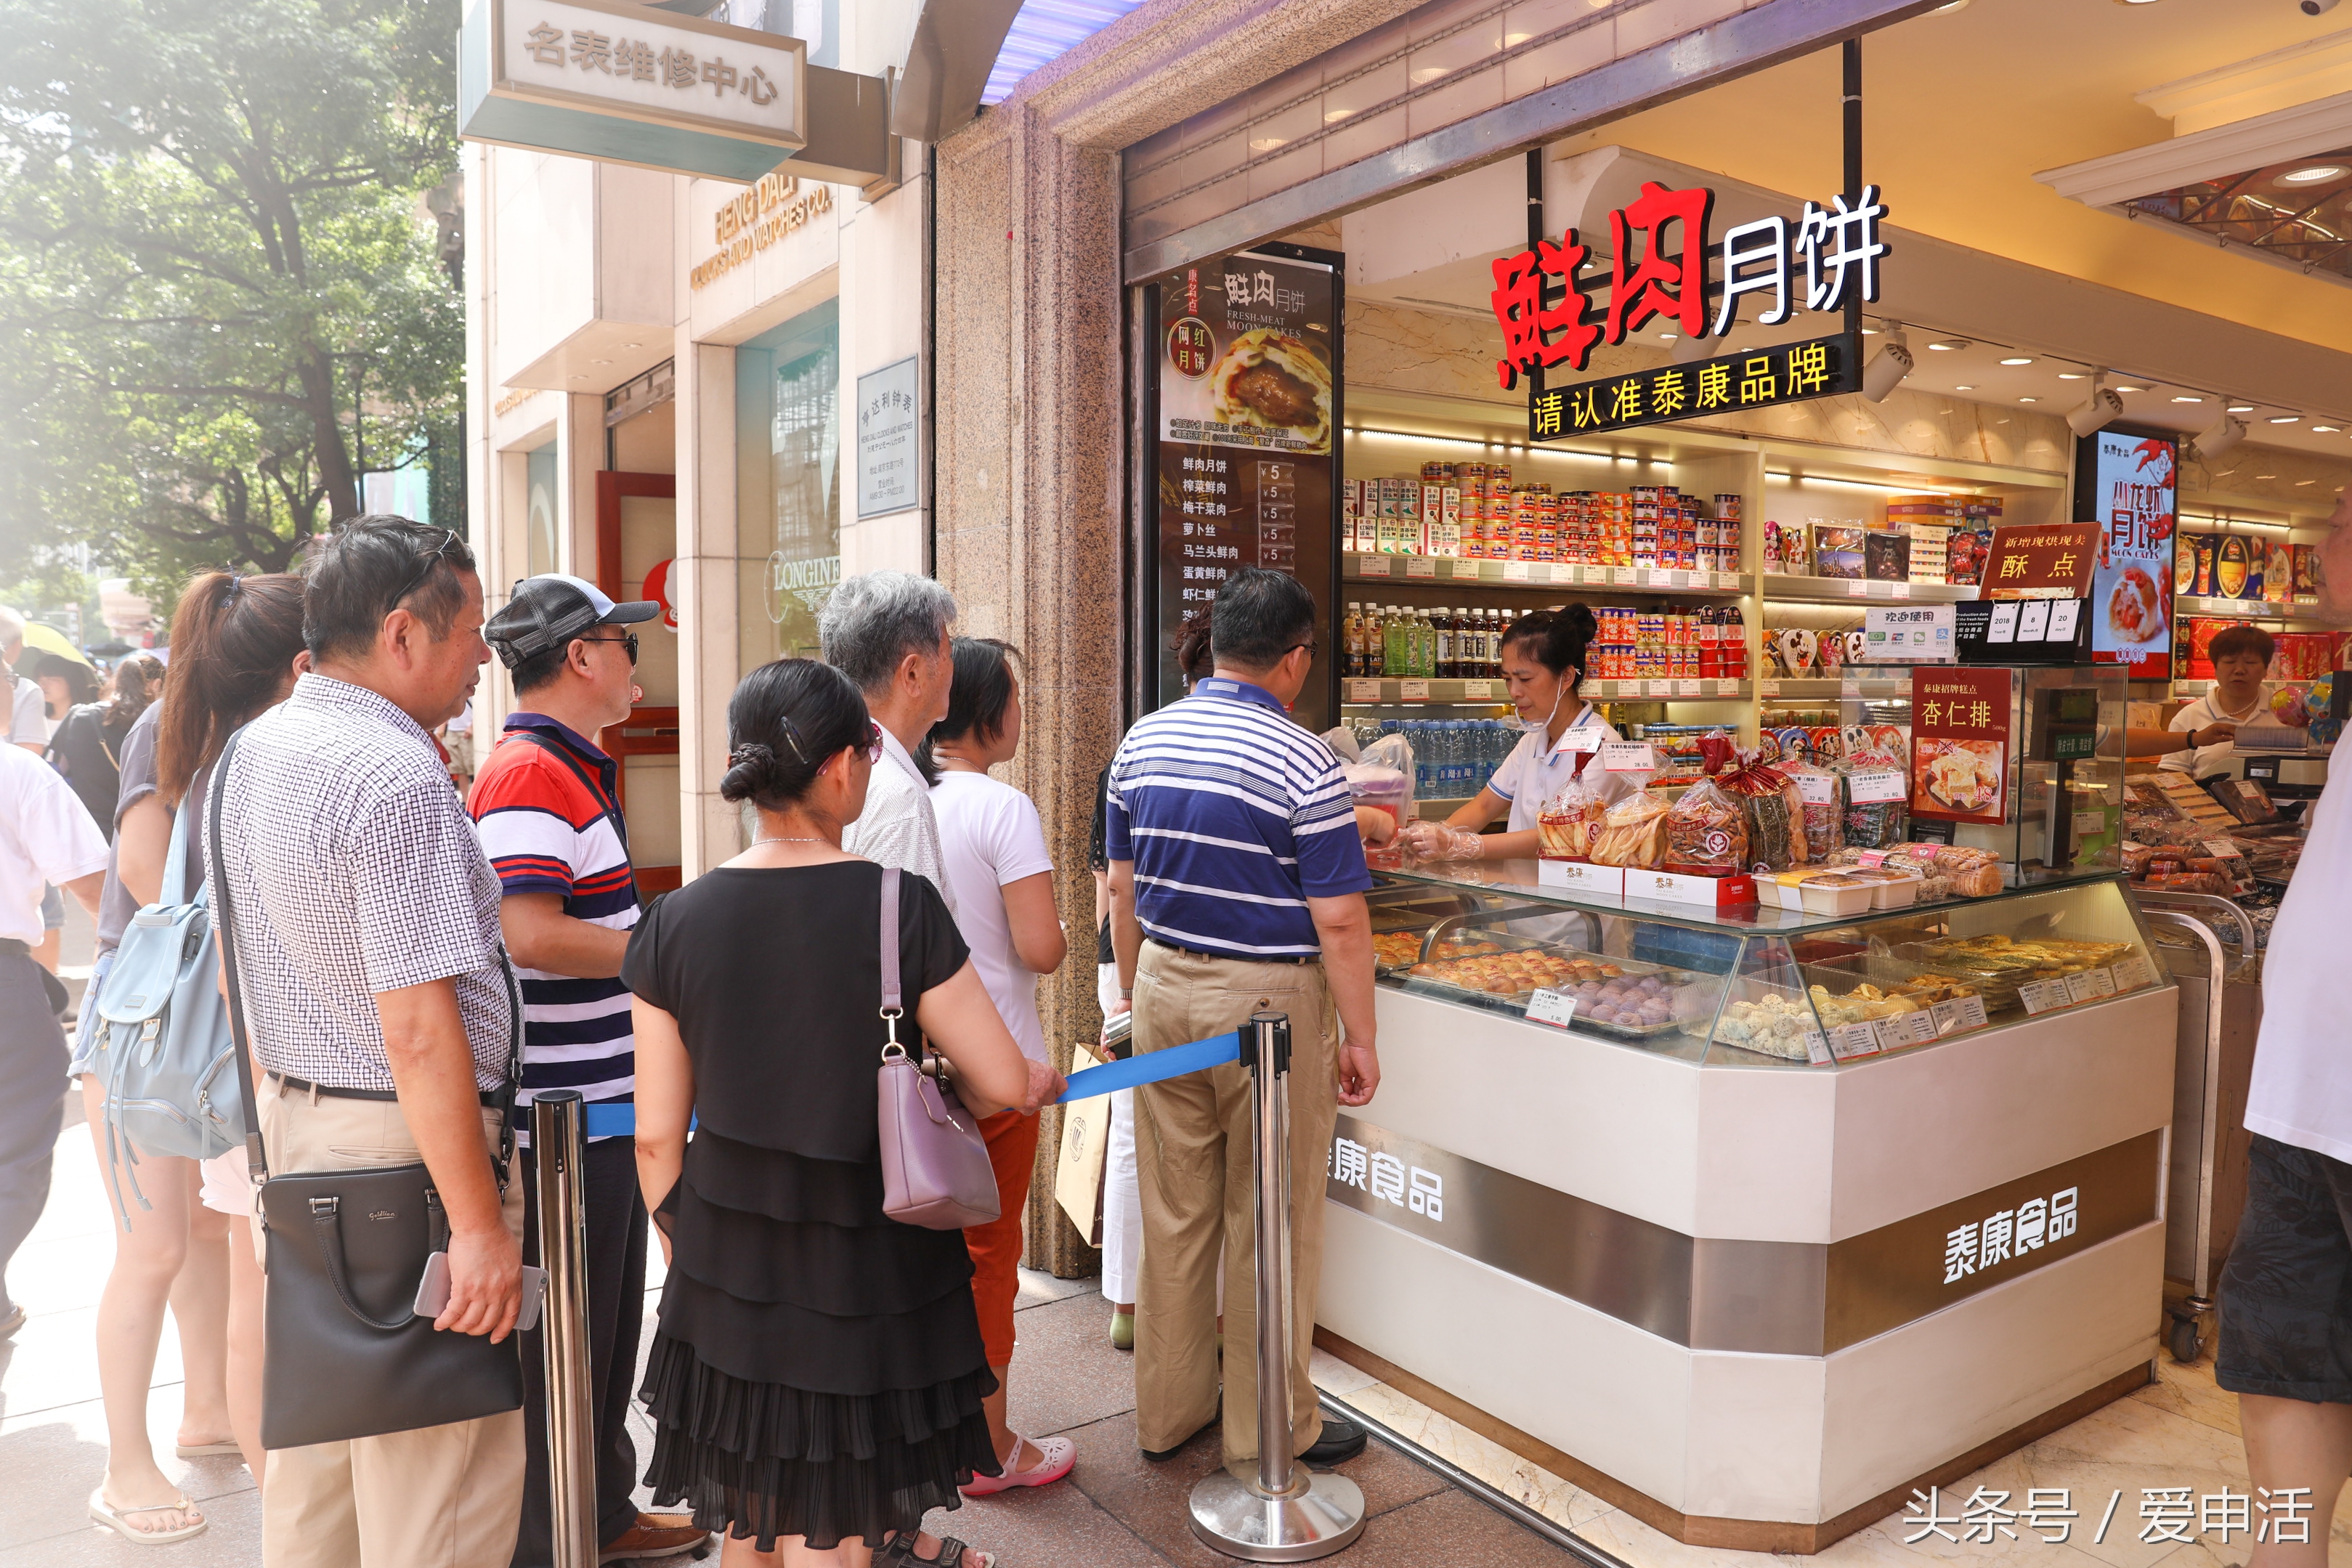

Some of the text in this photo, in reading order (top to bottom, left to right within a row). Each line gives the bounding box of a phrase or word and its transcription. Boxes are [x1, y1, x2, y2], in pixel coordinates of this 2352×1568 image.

[524, 20, 778, 106] 名表维修中心
[715, 174, 798, 245] HENG DALI
[691, 184, 832, 291] CLOCKS AND WATCHES CO.
[1225, 269, 1306, 314] 鲜肉月饼
[1491, 181, 1884, 390] 鲜肉月饼
[1227, 309, 1285, 326] FRESH-MEAT
[1178, 325, 1205, 347] 网红
[1227, 320, 1302, 338] MOON CAKES
[1179, 350, 1205, 371] 月饼
[1533, 342, 1829, 436] 请认准泰康品牌
[1237, 425, 1262, 436] 手工制作
[2103, 444, 2129, 458] 泰康食品
[1183, 457, 1227, 474] 鲜肉月饼
[1183, 479, 1226, 495] 榨菜鲜肉
[2113, 480, 2162, 513] 小龙虾
[1183, 501, 1226, 516] 梅干菜肉
[1183, 522, 1216, 537] 萝卜丝
[2111, 508, 2162, 551] 月饼
[2005, 535, 2086, 548] 新增现烘现卖
[1183, 545, 1238, 559] 马兰头鲜肉
[1183, 566, 1226, 580] 蛋黄鲜肉
[2000, 552, 2077, 579] 酥点
[1183, 588, 1219, 601] 虾仁鲜
[1886, 612, 1934, 622] 欢迎使用
[1923, 683, 1977, 695] 泰康招牌糕点
[1921, 699, 1992, 728] 杏仁排
[1328, 1137, 1443, 1222] 康食品
[1943, 1186, 2078, 1284] 泰康食品
